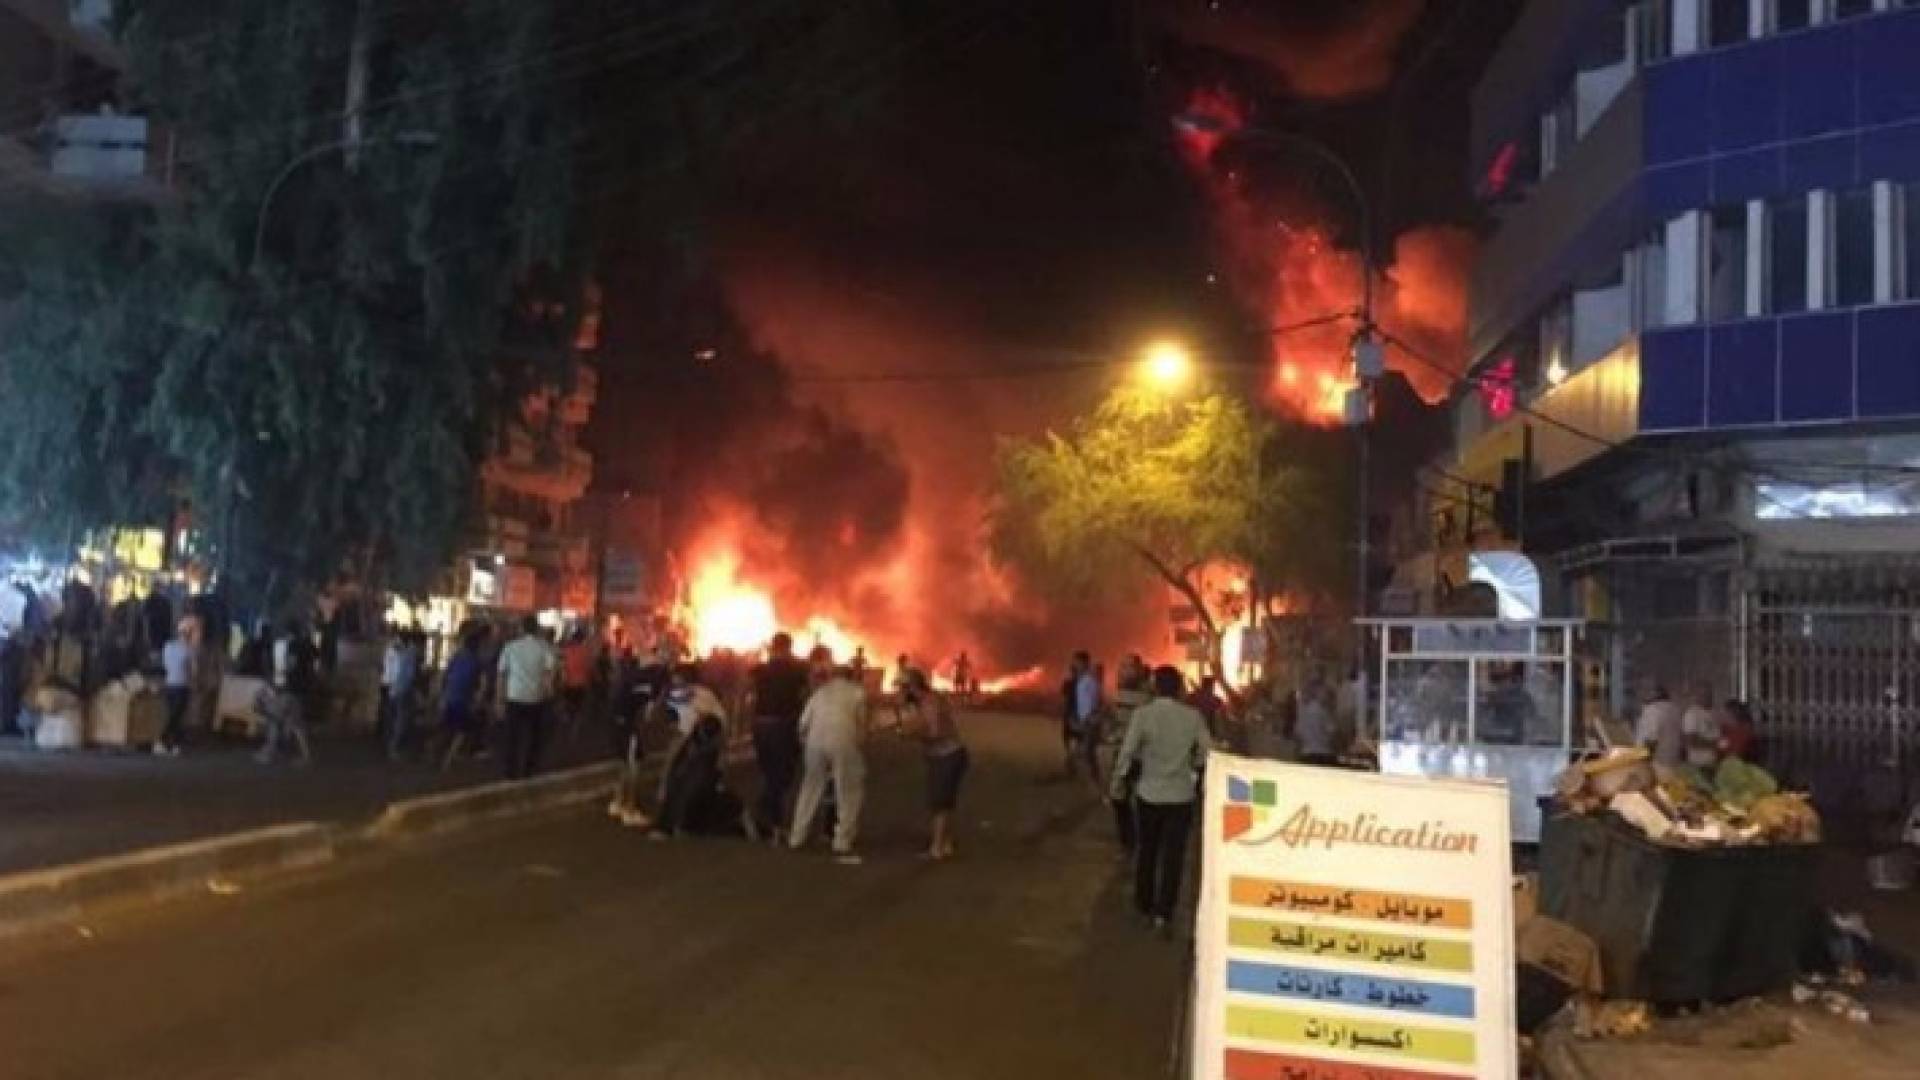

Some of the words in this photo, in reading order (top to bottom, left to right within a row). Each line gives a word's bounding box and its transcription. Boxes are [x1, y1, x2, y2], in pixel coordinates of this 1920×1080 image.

[1240, 802, 1478, 855] Application
[1263, 884, 1354, 913] كومبيوتر
[1376, 896, 1443, 924] موبايل
[1271, 925, 1336, 953] مراقبة
[1344, 932, 1427, 963] كاميرات
[1276, 970, 1344, 999] كارتات
[1365, 981, 1432, 1007] خطوط
